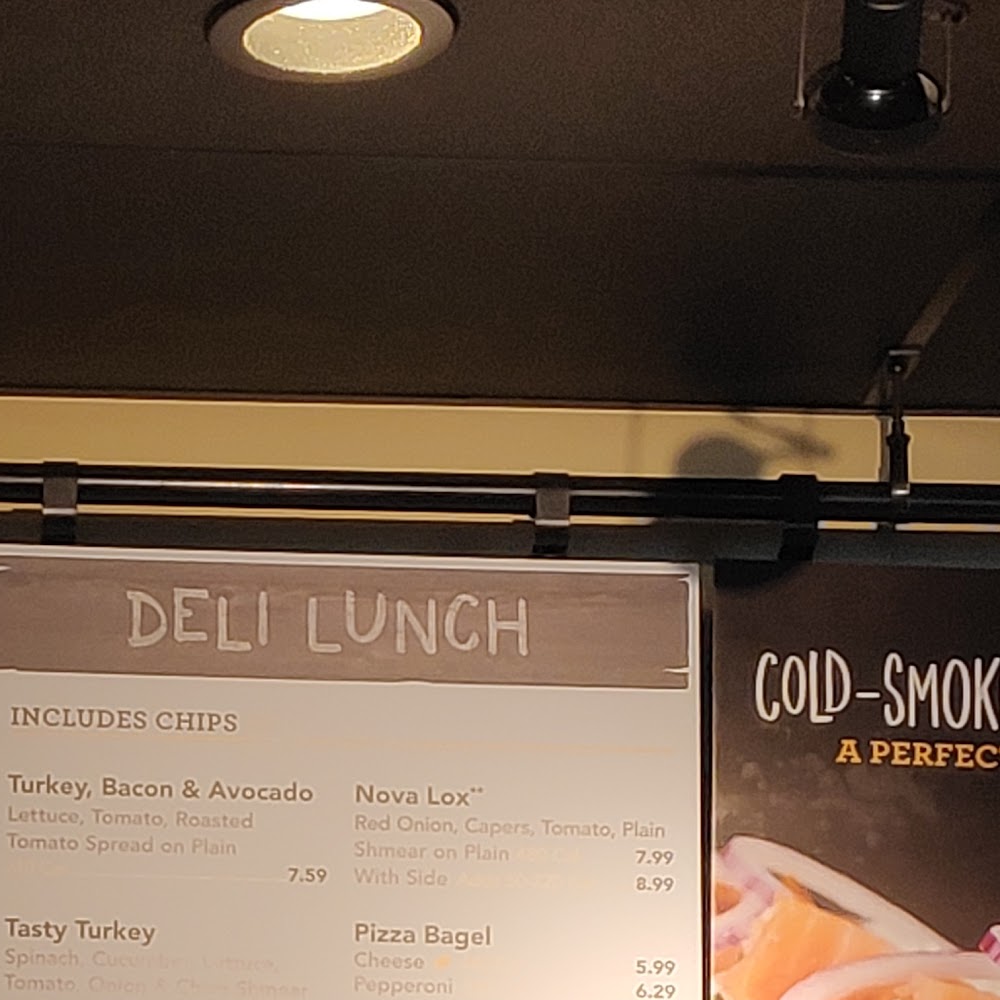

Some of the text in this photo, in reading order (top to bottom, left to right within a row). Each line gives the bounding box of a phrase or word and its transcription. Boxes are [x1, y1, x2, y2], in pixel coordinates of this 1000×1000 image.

[126, 588, 529, 657] DELI LUNCH
[10, 706, 238, 732] INCLUDES CHIPS
[835, 739, 1000, 769] A PERFEC
[8, 774, 314, 802] Turkey, Bacon & Avocado
[355, 784, 419, 805] Nova
[7, 805, 254, 829] Lettuce, Tomato, Roasted
[354, 814, 666, 839] Red Onion, Capers, Tomato, Plain
[7, 832, 237, 856] Tomato Spread Plain
[464, 844, 510, 862] Plain
[635, 850, 674, 866] 7.99
[287, 867, 327, 884] 7.59
[354, 868, 400, 886] With
[406, 869, 448, 887] Side
[635, 876, 675, 892] 8.99
[4, 917, 156, 947] Tasty Turkey
[354, 923, 492, 951] Pizza Bagel
[354, 951, 676, 976] Cheese 5.99
[354, 976, 676, 1000] Pepperoni 6.29
